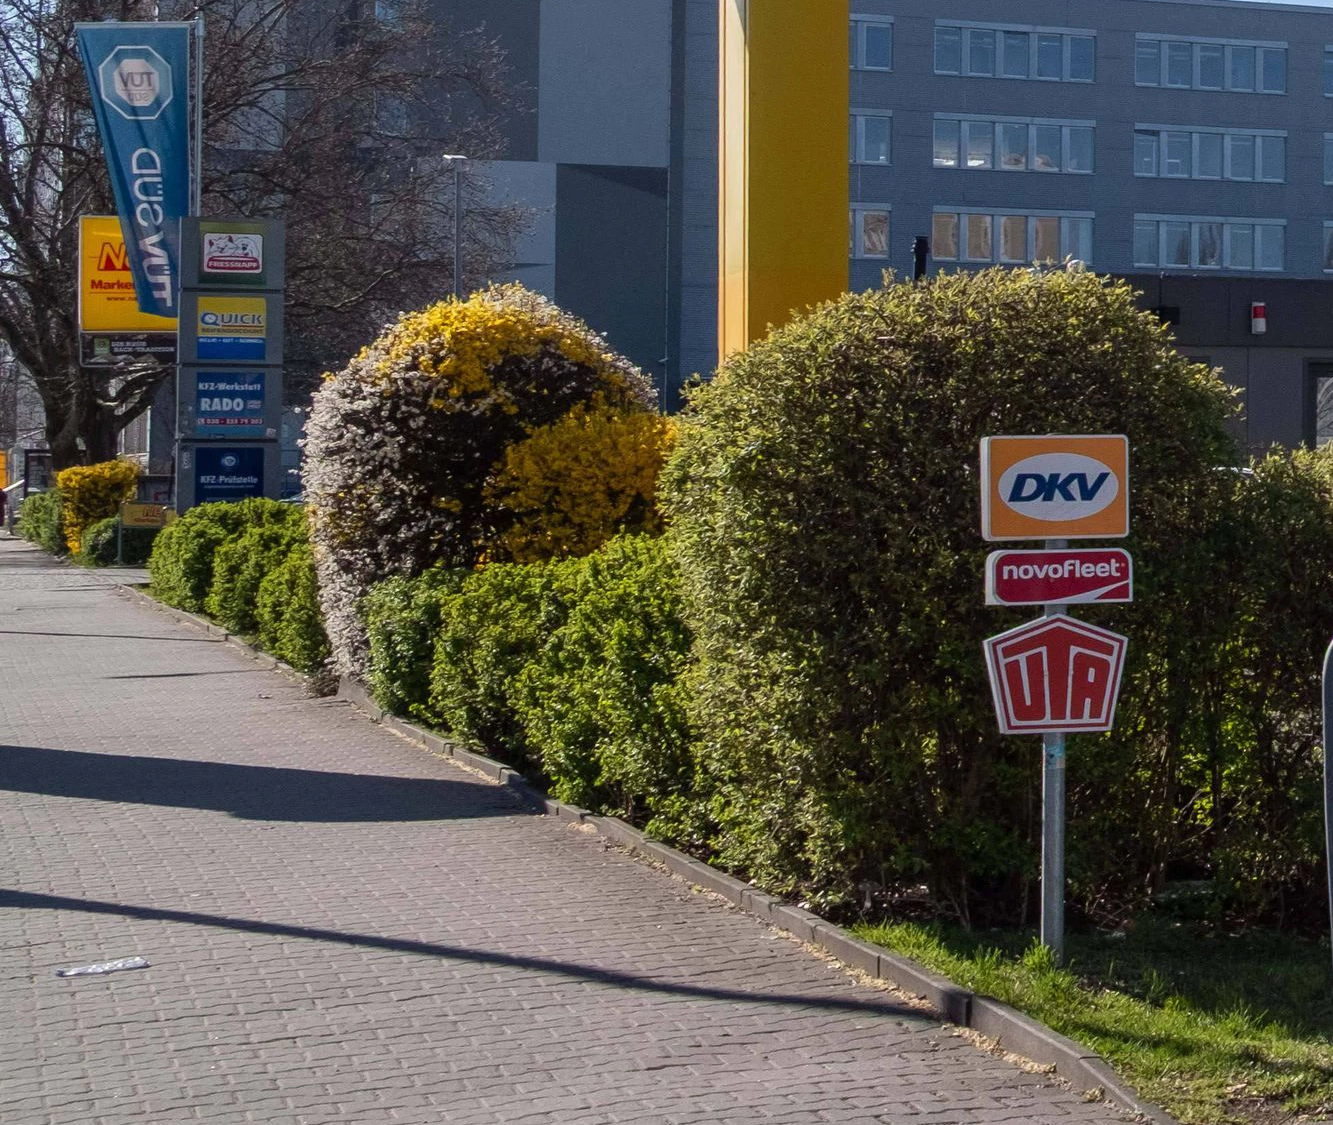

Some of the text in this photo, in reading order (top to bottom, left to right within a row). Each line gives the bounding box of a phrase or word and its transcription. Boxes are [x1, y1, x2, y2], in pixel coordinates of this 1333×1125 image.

[208, 260, 258, 269] FRESSNAPF
[201, 312, 262, 326] QUICK
[198, 382, 261, 391] KFZ-Werkstatt
[200, 397, 244, 412] RADO
[1007, 472, 1111, 502] DKV
[1002, 559, 1121, 580] novofleet
[1001, 625, 1115, 722] UTA
